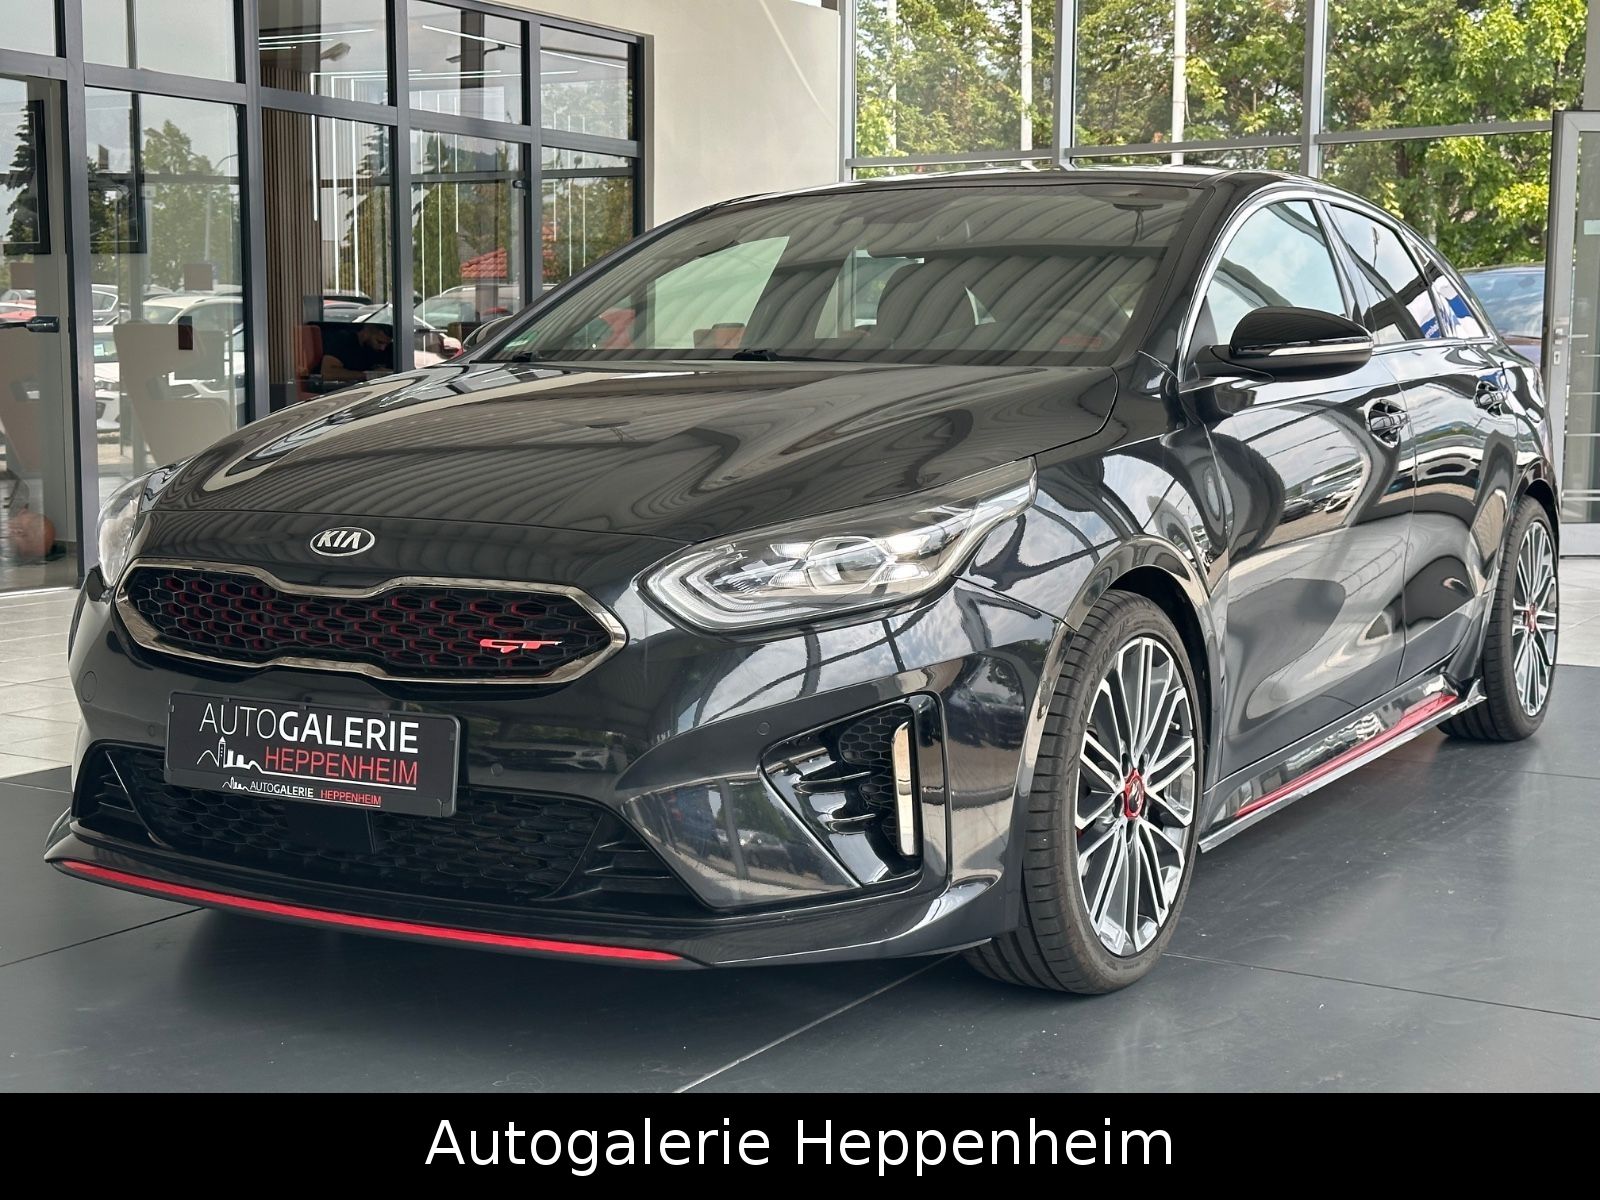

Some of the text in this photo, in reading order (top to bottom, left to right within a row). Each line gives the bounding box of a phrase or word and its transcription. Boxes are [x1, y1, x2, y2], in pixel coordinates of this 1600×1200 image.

[316, 530, 362, 549] KIA
[480, 638, 563, 654] GT
[199, 703, 419, 754] AUTOGALERIE
[264, 746, 418, 786] HEPPENHEIM
[249, 780, 382, 806] AUTOGALERIE HEPPENHEIM
